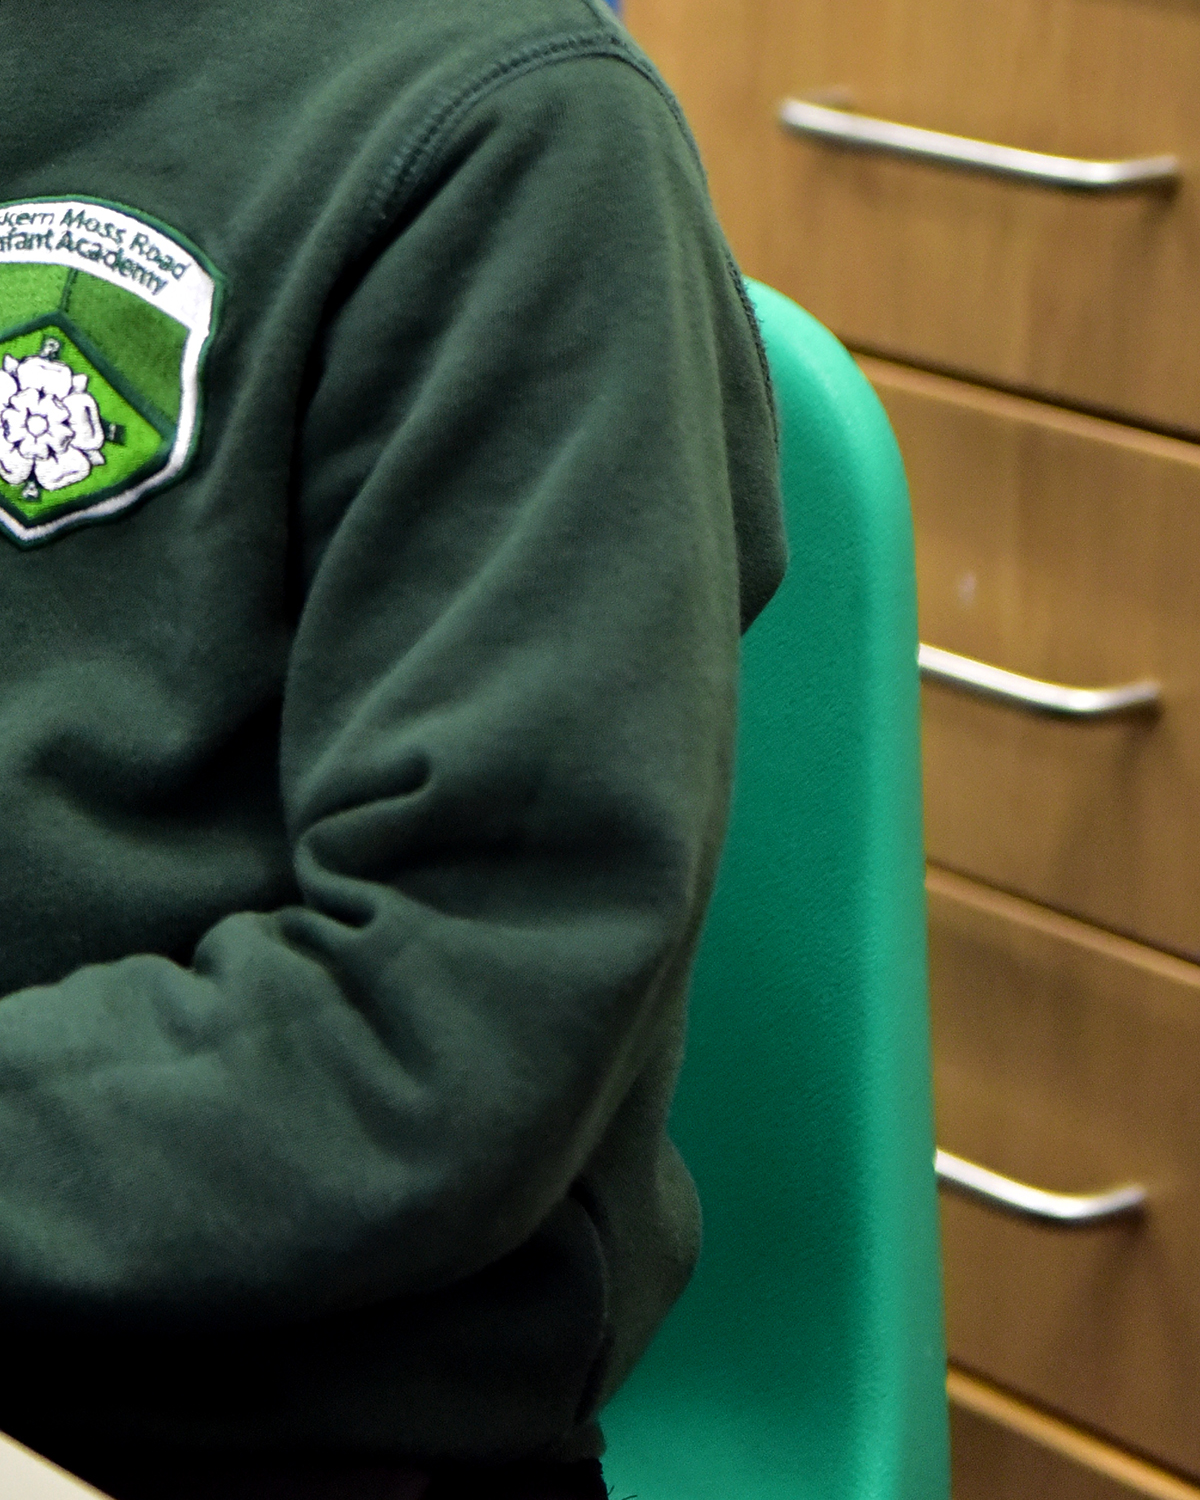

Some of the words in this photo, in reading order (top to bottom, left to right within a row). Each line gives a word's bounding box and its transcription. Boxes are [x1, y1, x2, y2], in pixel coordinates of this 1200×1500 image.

[54, 230, 169, 296] Academy
[59, 208, 127, 245] Moss
[128, 231, 192, 281] Road
